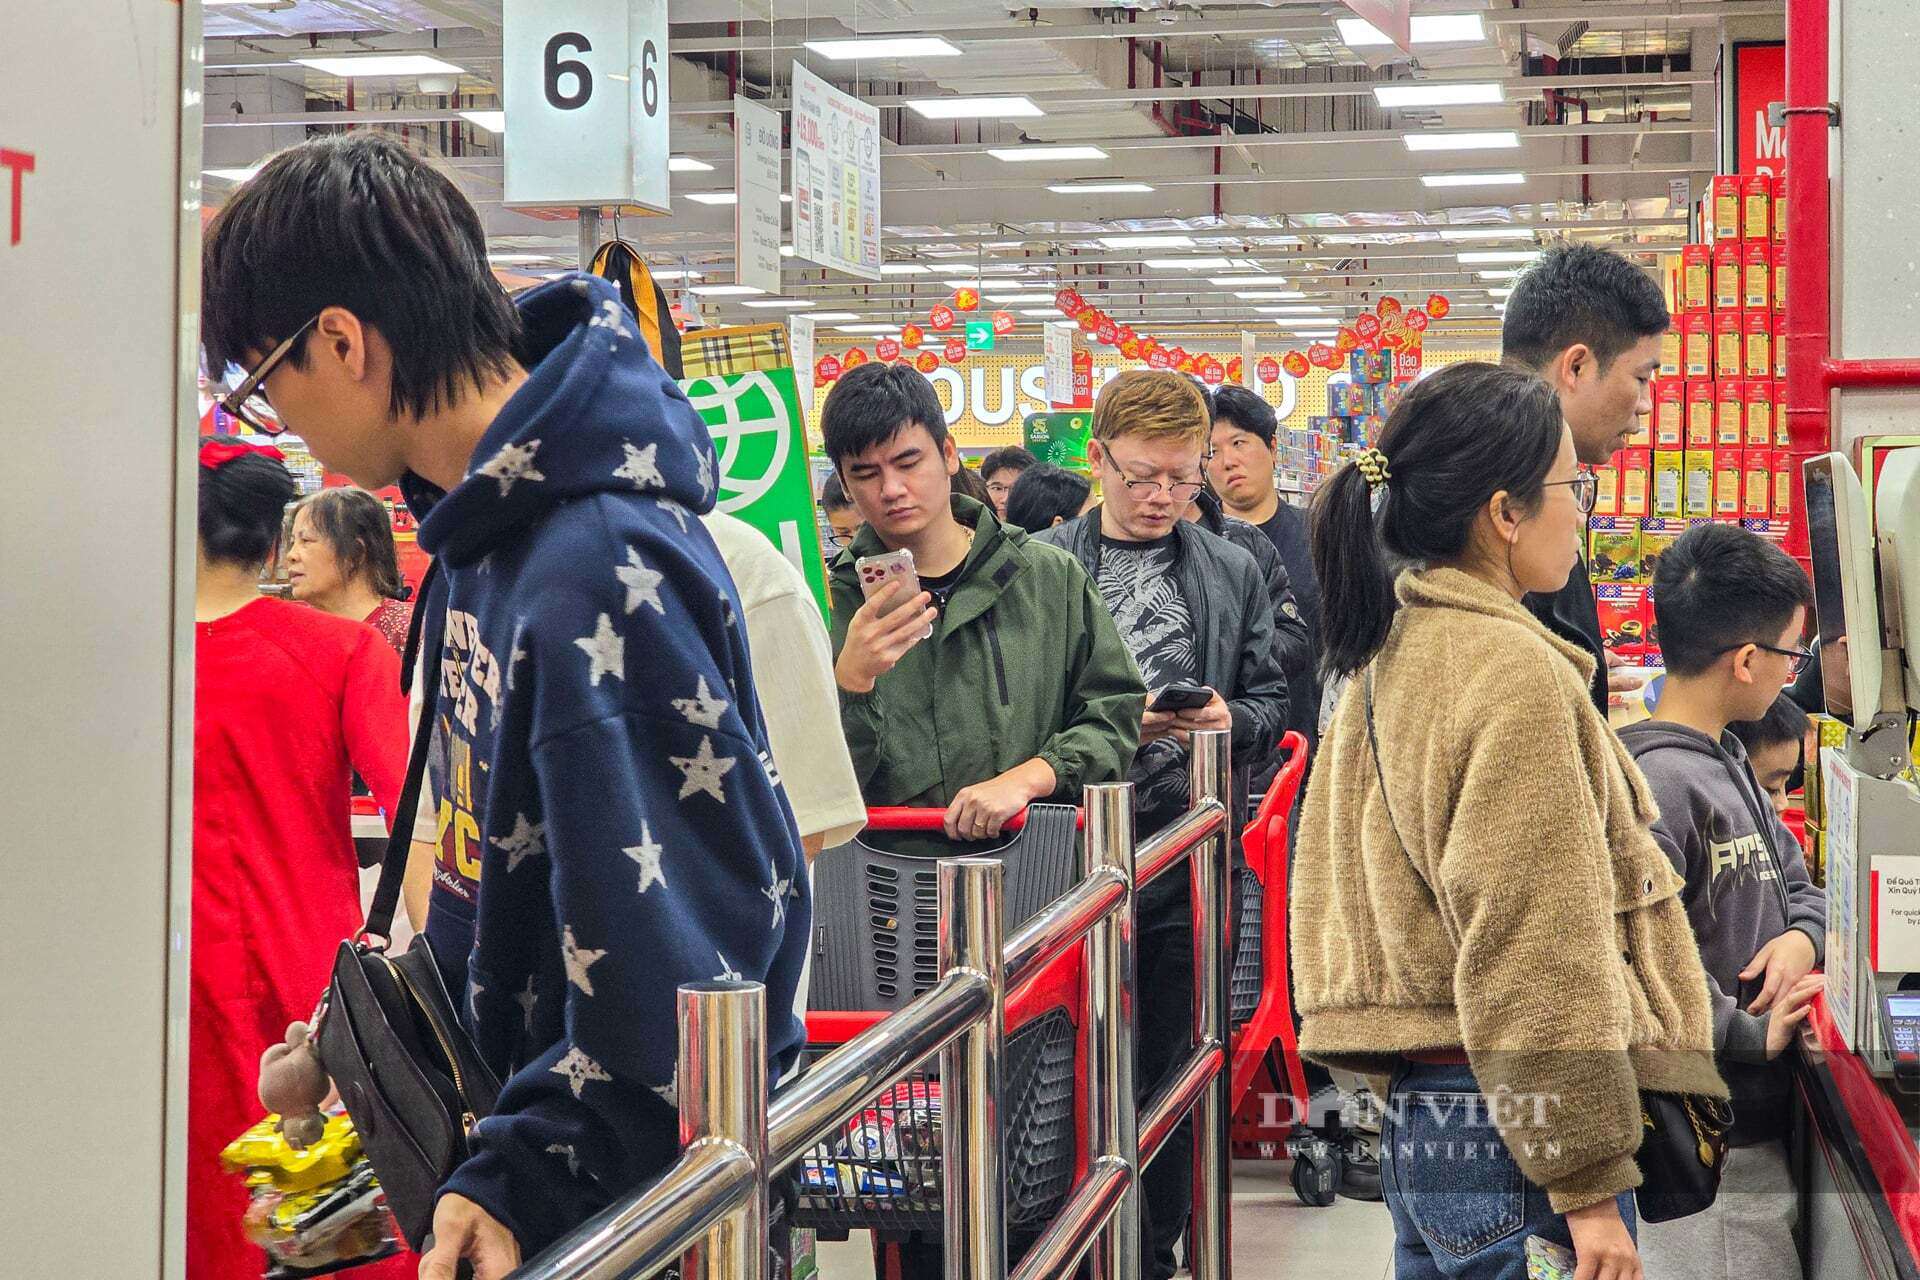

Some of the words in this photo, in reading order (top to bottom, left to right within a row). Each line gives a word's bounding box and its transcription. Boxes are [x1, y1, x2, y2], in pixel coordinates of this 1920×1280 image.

[544, 31, 593, 110] 6
[641, 39, 658, 118] 6
[1888, 886, 1901, 894] Xin
